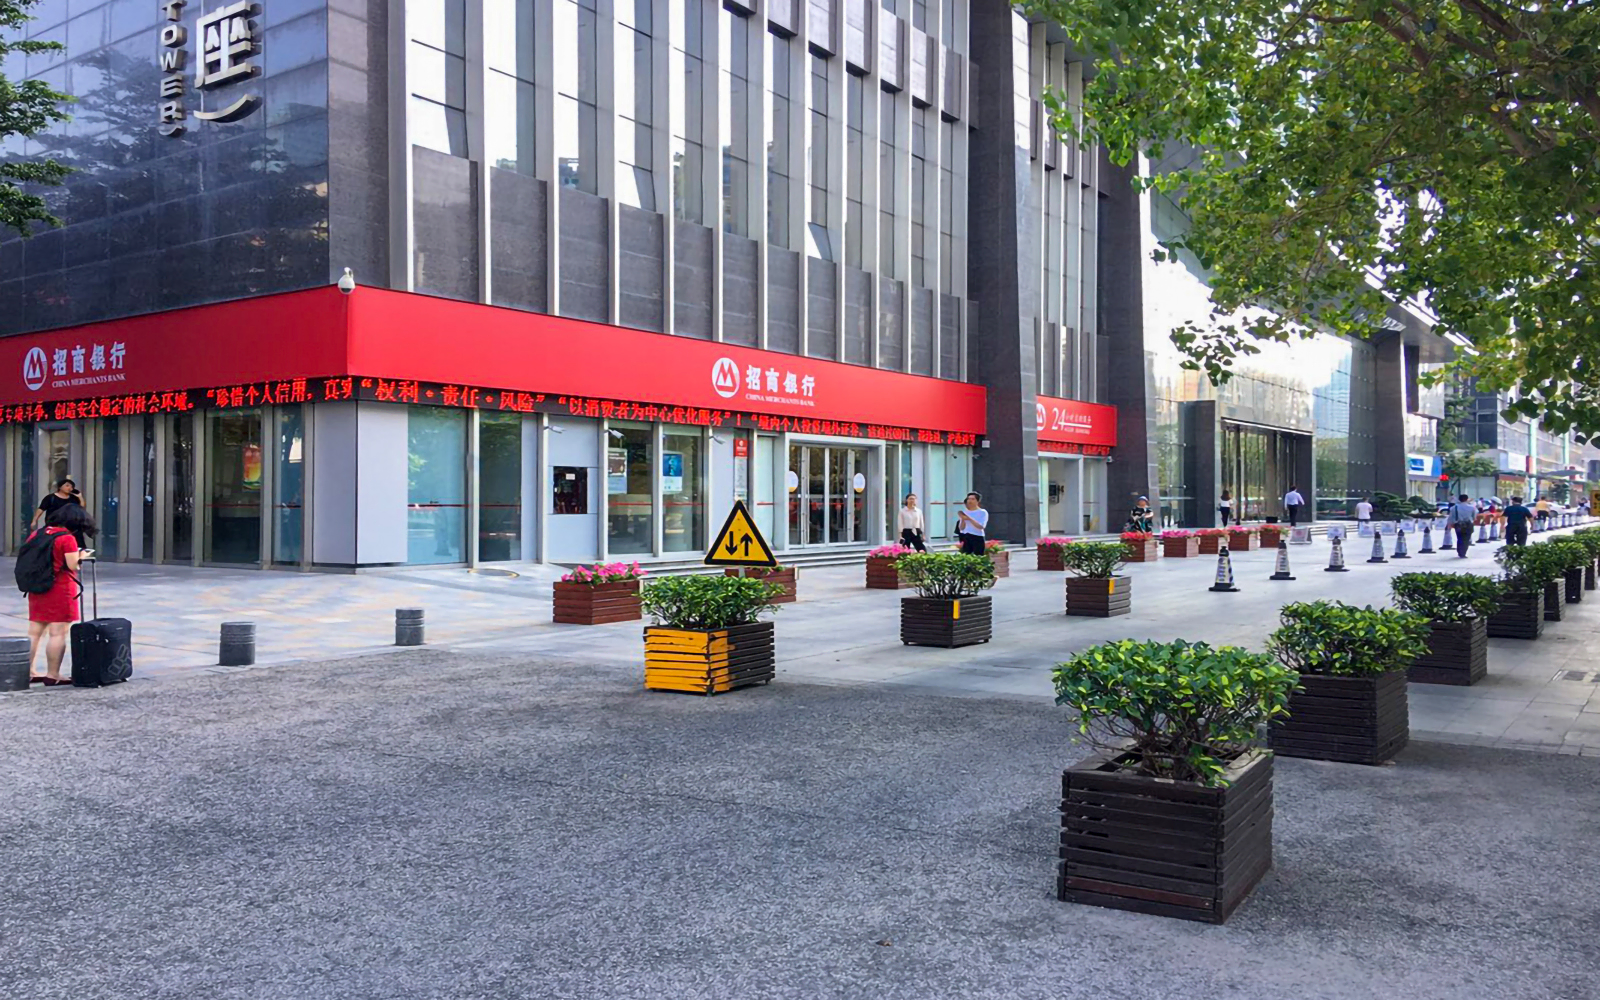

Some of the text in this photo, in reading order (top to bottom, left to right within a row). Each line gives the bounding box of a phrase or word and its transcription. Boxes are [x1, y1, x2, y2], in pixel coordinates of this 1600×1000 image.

[52, 341, 126, 376] 招商银行
[52, 373, 126, 388] CHINA MERCHANTS BANK
[745, 365, 815, 397] 招商银行
[745, 393, 815, 407] CHINA MERCHANTS BANK
[1051, 407, 1066, 431] 24
